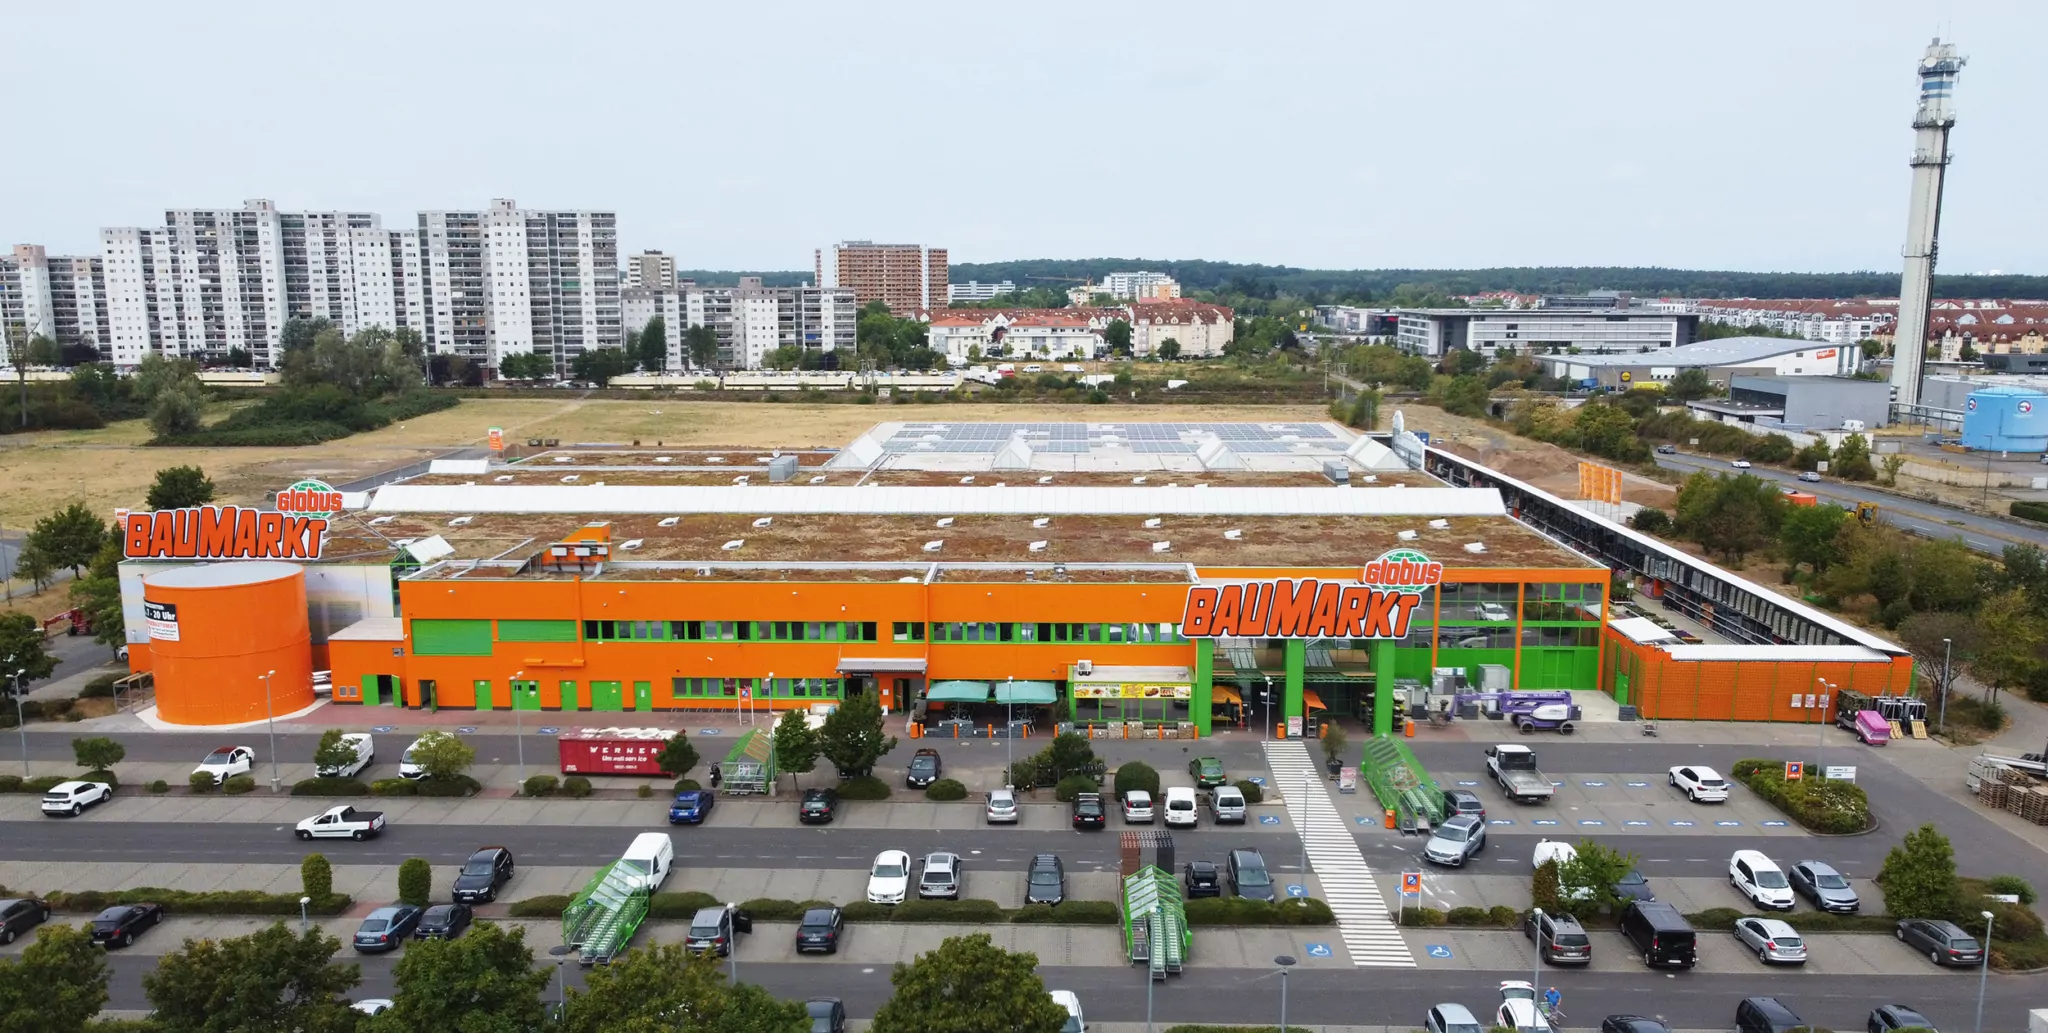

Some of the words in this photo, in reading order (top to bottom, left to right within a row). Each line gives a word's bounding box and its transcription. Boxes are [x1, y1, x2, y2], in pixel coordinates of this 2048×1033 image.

[126, 507, 327, 558] BAUMARKT
[153, 610, 161, 619] 20
[162, 611, 176, 620] Uhr
[1182, 578, 1421, 637] BAUMARKT
